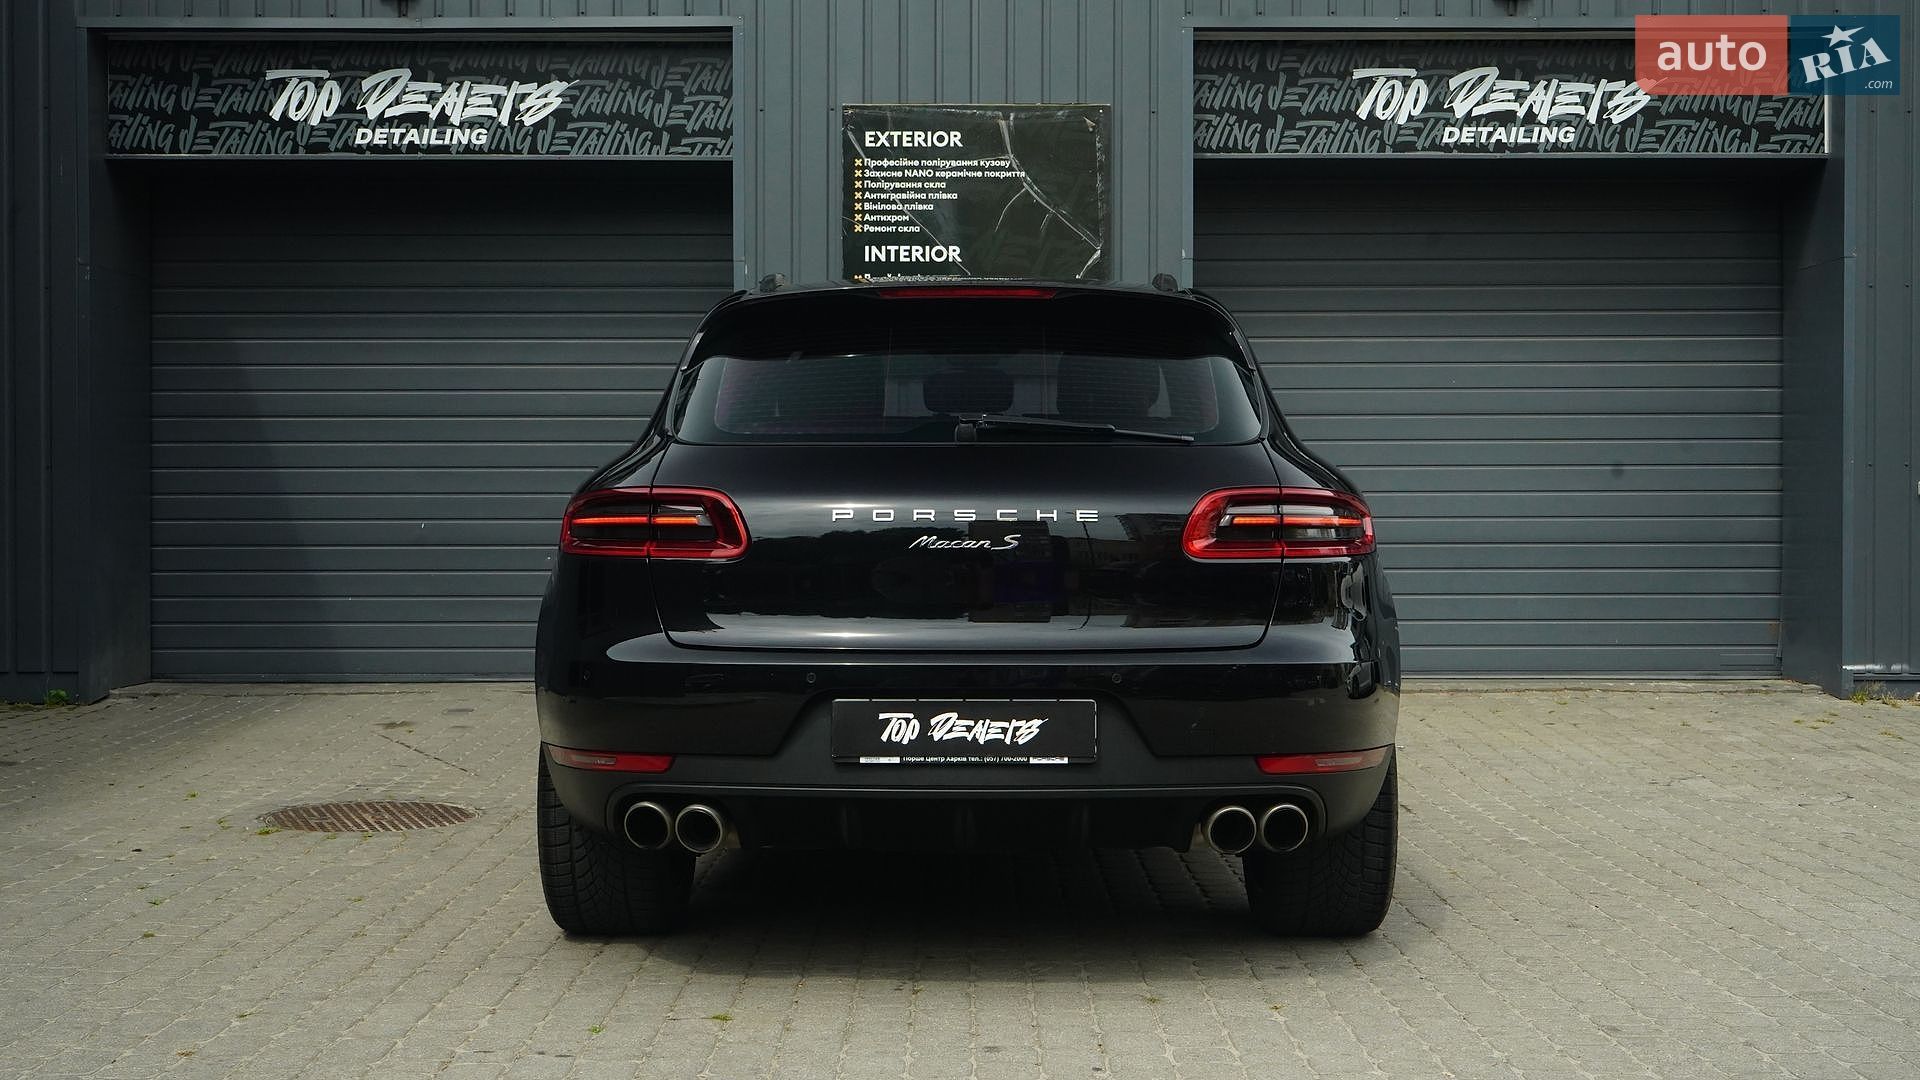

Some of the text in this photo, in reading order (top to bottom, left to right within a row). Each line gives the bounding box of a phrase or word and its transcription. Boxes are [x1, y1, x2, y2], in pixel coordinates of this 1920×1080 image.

[355, 128, 488, 145] DETAILING
[864, 131, 963, 148] EXTERIOR
[1441, 127, 1576, 144] DETAILING
[864, 158, 1011, 169] Професійне полірування кузову
[864, 169, 1026, 180] Захисне NANO керамічне покриття
[864, 180, 923, 191] Полірування
[864, 191, 958, 202] Антигравійна плівка
[864, 202, 934, 211] Вінілова плівка
[864, 213, 910, 224] Антихром
[864, 224, 921, 233] Ремонт скла
[864, 246, 962, 263] INTERIOR
[832, 509, 1099, 522] PORSCHE
[909, 534, 1022, 551] Macan S
